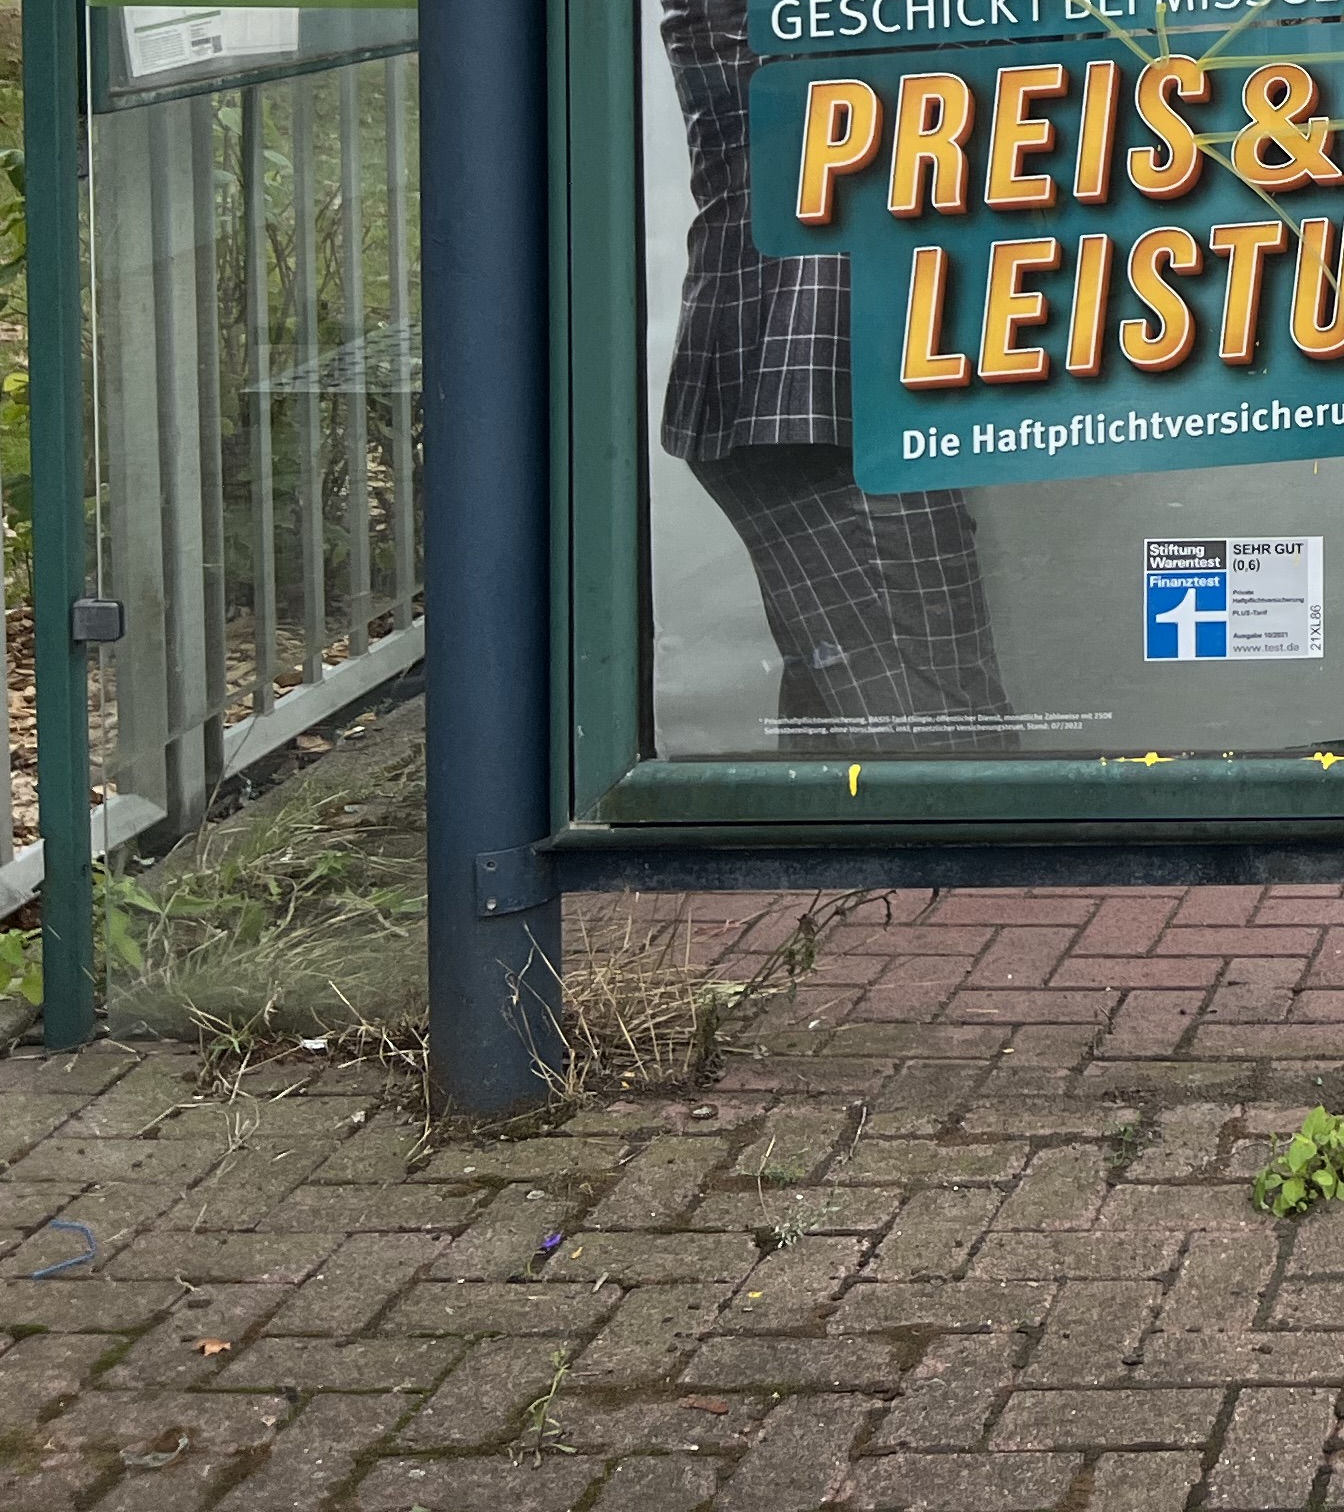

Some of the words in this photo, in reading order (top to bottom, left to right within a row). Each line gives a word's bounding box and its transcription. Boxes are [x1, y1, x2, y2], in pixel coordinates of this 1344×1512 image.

[795, 53, 1212, 226] PREIS
[901, 426, 960, 462] Die
[1149, 543, 1206, 558] Stiftung
[1233, 543, 1272, 555] SEHR
[1274, 542, 1304, 555] GUT
[1149, 556, 1221, 569] Warentest
[1232, 558, 1261, 573] (0,6)
[1149, 575, 1220, 588] Finanztest
[1310, 604, 1322, 651] 21XL86
[1233, 642, 1300, 653] www.test.de
